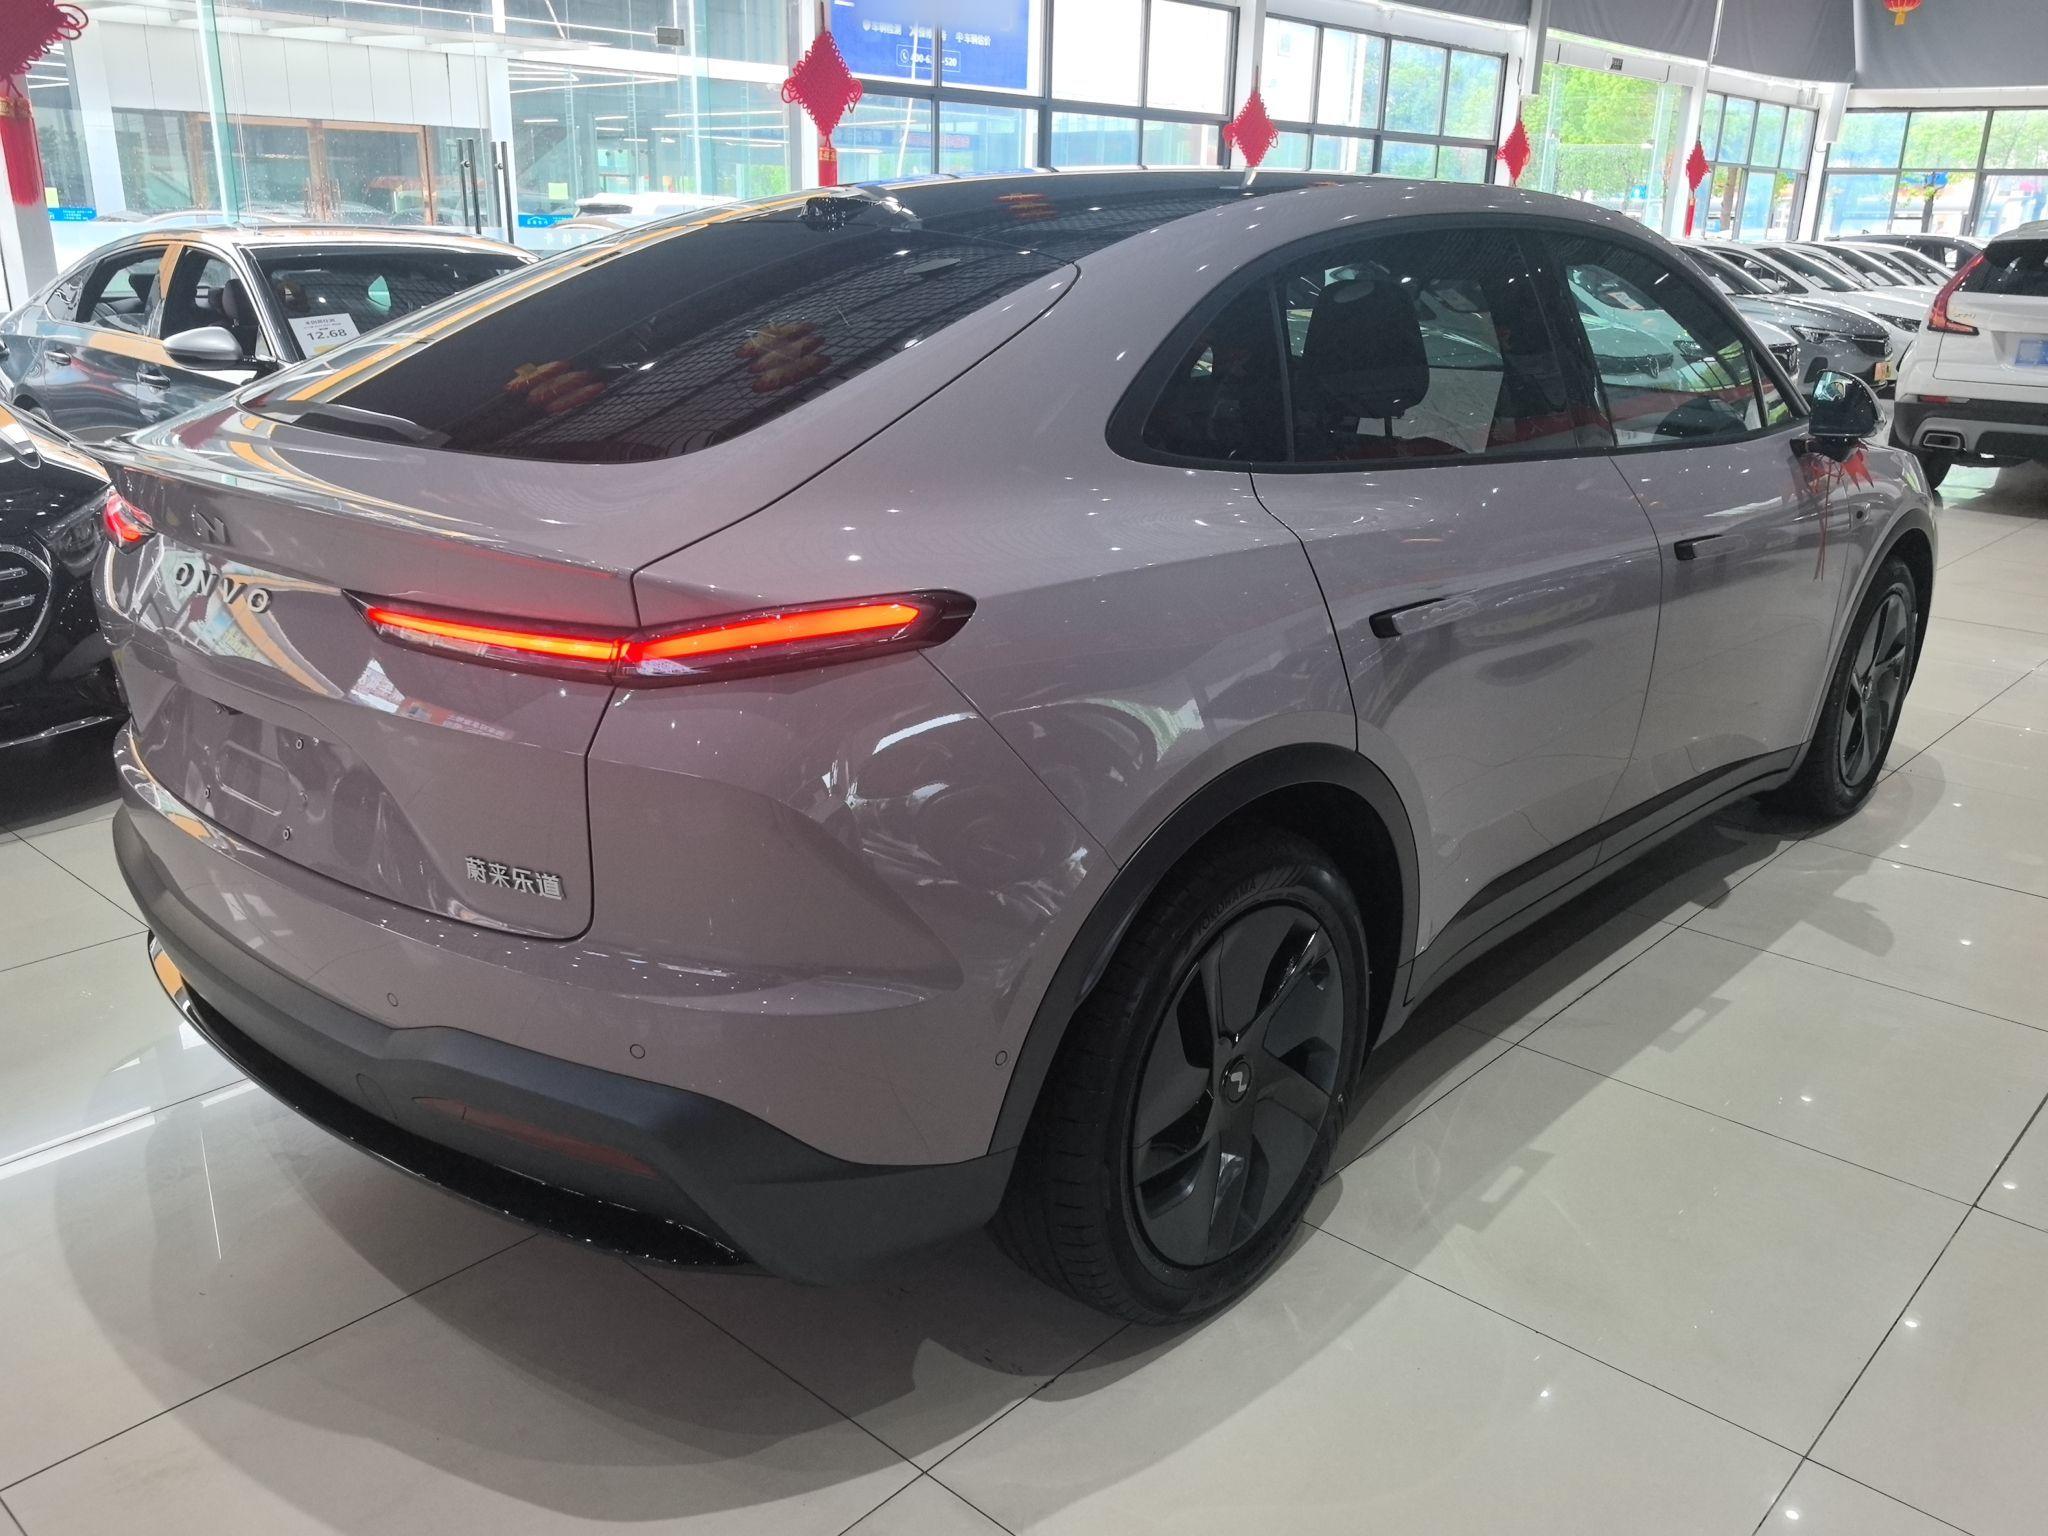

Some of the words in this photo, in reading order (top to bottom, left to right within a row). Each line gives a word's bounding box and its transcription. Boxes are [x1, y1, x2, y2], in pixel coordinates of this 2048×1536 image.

[306, 328, 348, 341] 12.68
[176, 562, 273, 614] ONVO
[464, 855, 567, 901] 蔚来乐道
